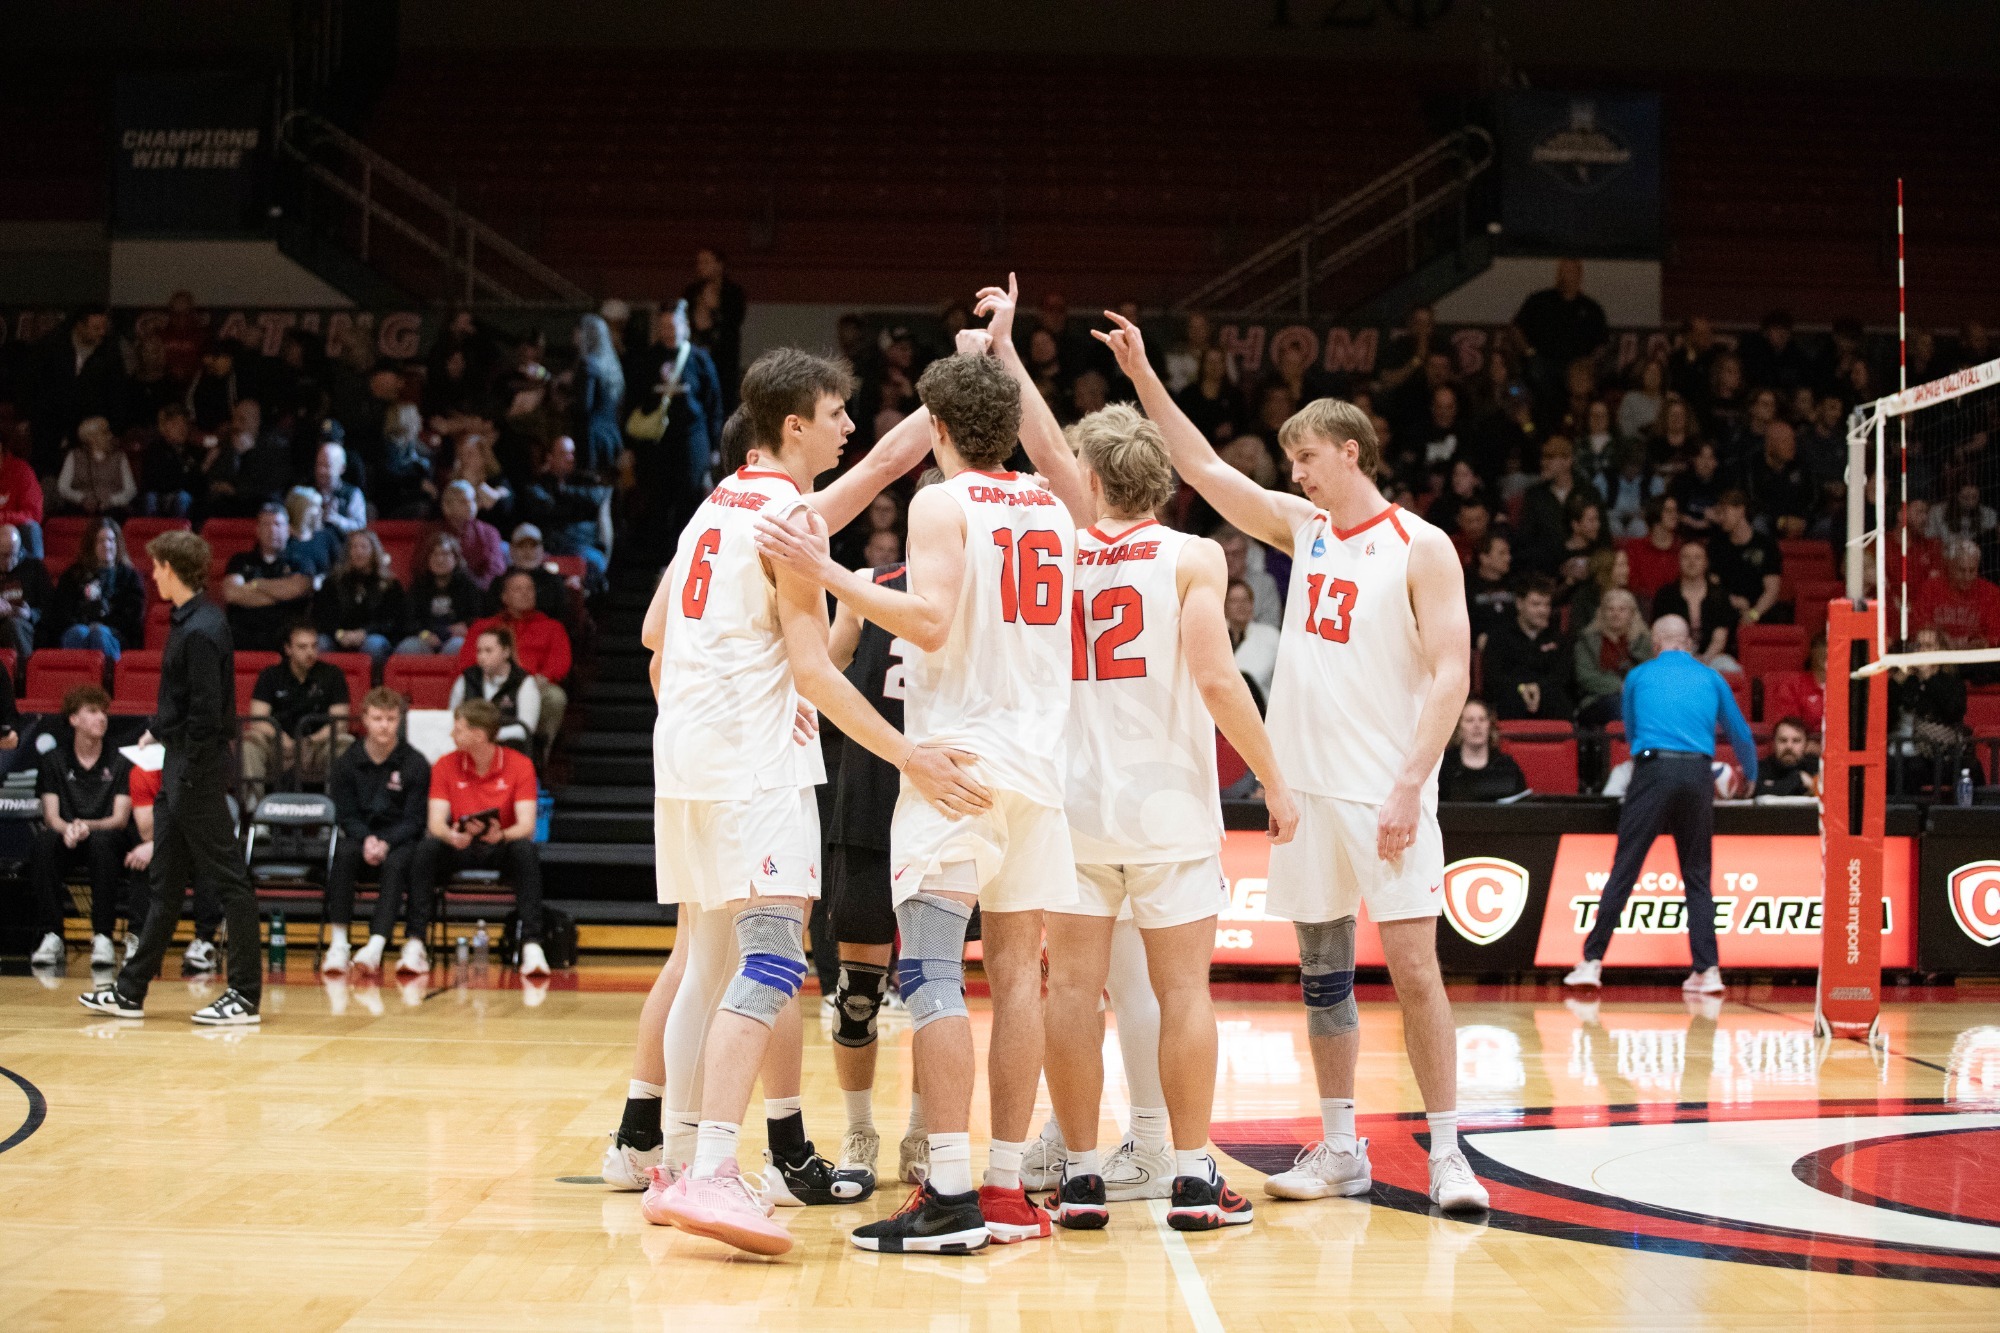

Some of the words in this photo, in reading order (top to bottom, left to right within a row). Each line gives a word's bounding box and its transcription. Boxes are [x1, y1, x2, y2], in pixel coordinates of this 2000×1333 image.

[707, 486, 771, 511] ARTHAGE
[682, 528, 721, 620] 6
[992, 527, 1063, 625] 16
[1077, 541, 1162, 566] RTHAGE
[1306, 573, 1359, 644] 13
[1071, 585, 1147, 681] 12
[1466, 877, 1504, 923] C
[1724, 873, 1758, 892] TO
[1847, 858, 1862, 906] sports
[1570, 896, 1738, 934] TRBE
[1738, 896, 1892, 934] ARE
[1845, 907, 1860, 965] imports
